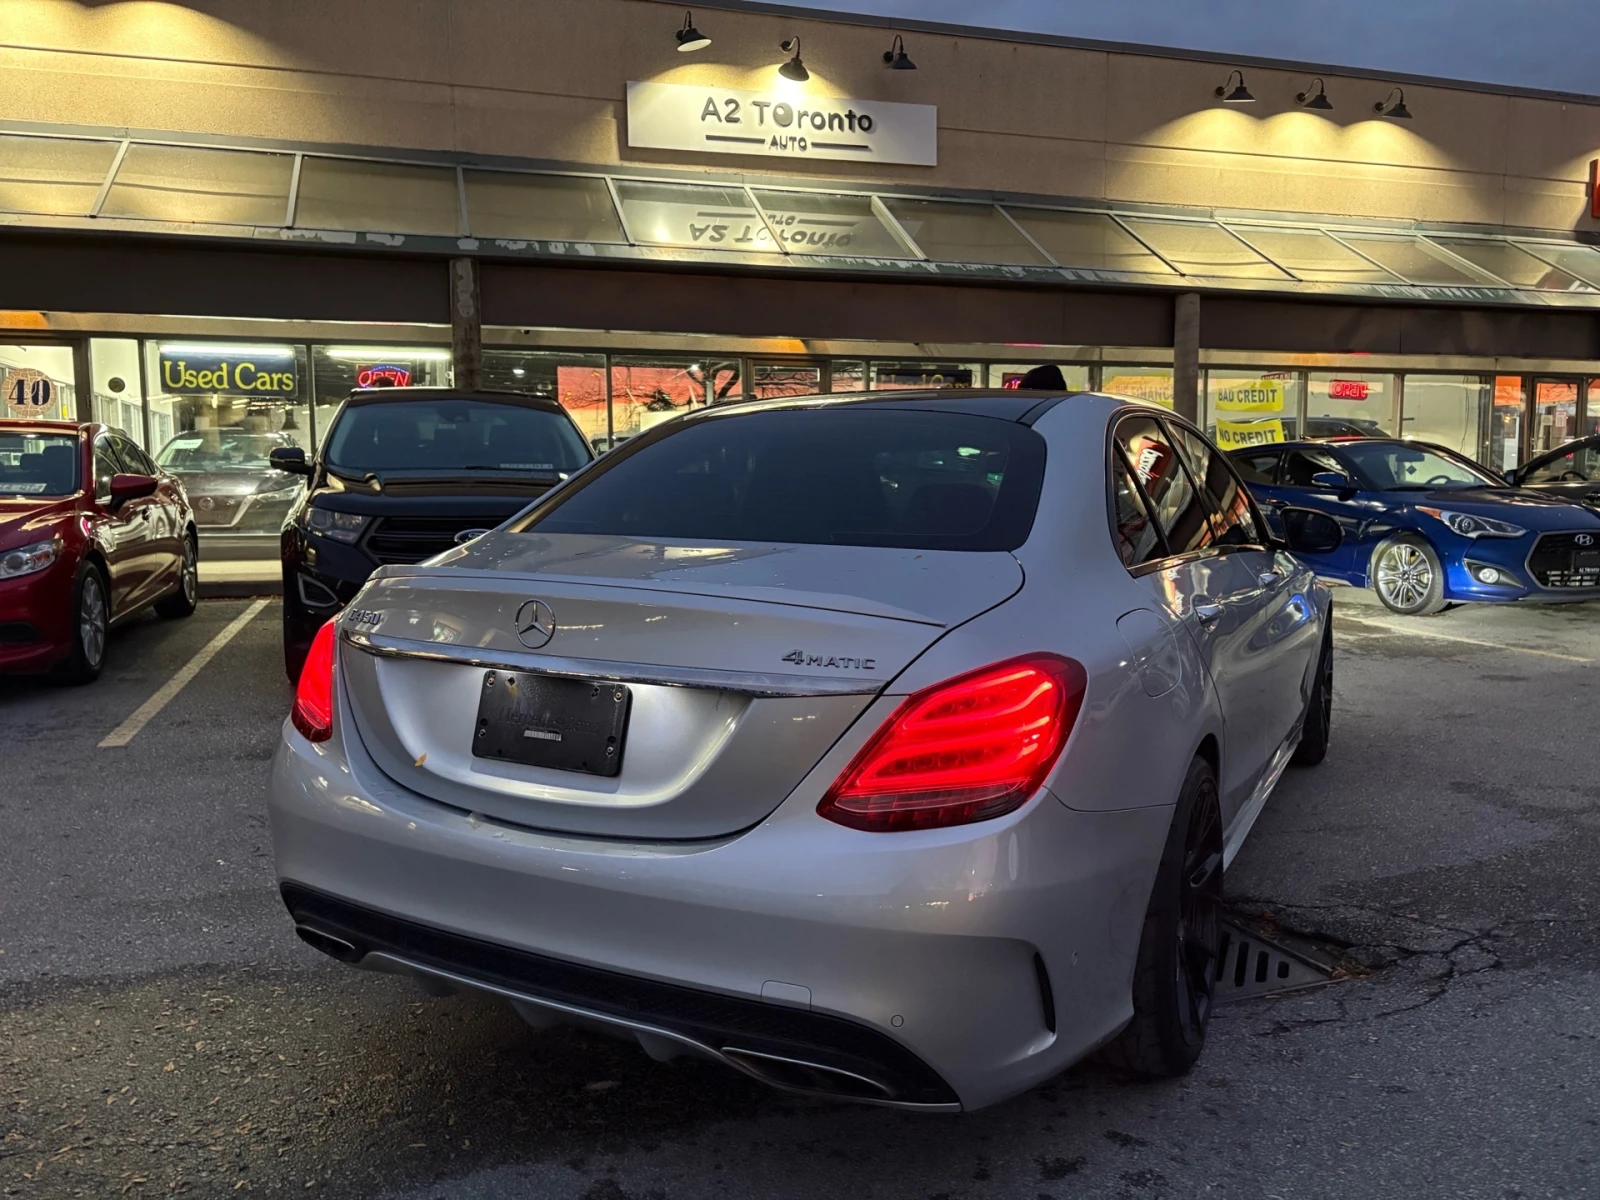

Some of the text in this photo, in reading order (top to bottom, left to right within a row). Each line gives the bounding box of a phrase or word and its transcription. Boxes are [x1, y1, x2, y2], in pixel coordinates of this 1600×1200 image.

[701, 97, 742, 124] A2
[769, 135, 807, 151] AUTO
[164, 361, 294, 391] Used Cars
[9, 379, 51, 406] 40
[1131, 385, 1174, 400] FINANC
[1218, 388, 1277, 403] BAD CREDIT
[1333, 382, 1367, 397] OPEN
[1218, 427, 1276, 444] NO CREDIT
[781, 649, 875, 670] 4MATIC
